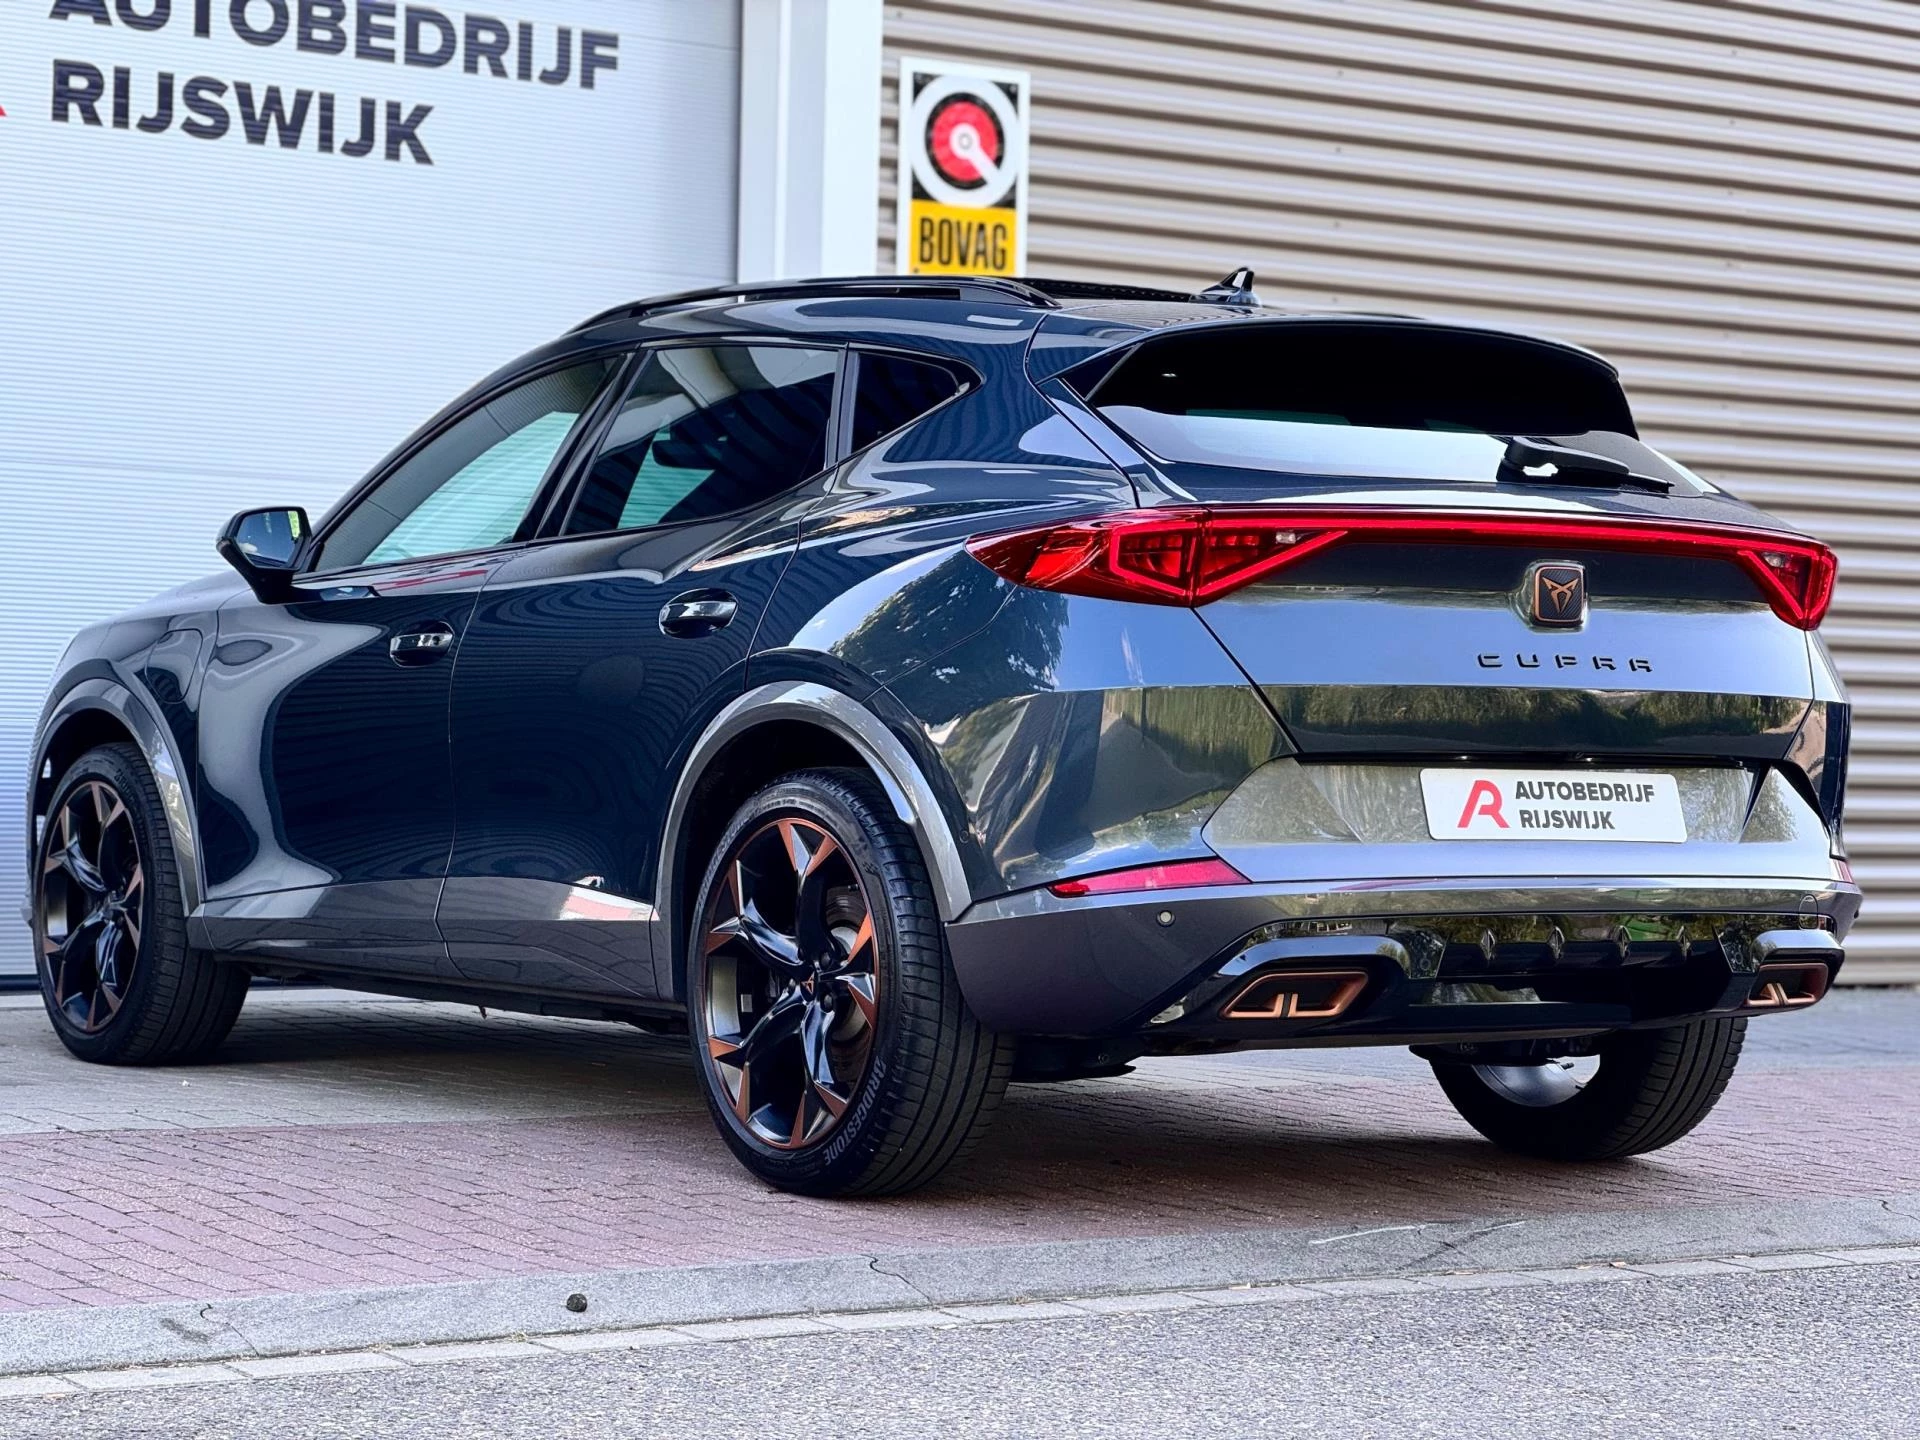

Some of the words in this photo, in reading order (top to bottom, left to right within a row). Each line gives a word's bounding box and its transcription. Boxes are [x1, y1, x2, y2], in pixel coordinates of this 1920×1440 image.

[52, 58, 435, 166] RIJSWIJK
[919, 216, 1008, 271] BOVAG
[1477, 653, 1653, 673] CUPRA
[1515, 780, 1655, 803] AUTOBEDRIJF
[1519, 809, 1616, 830] RIJSWIJK
[823, 1055, 887, 1167] BRIDGESTONE
